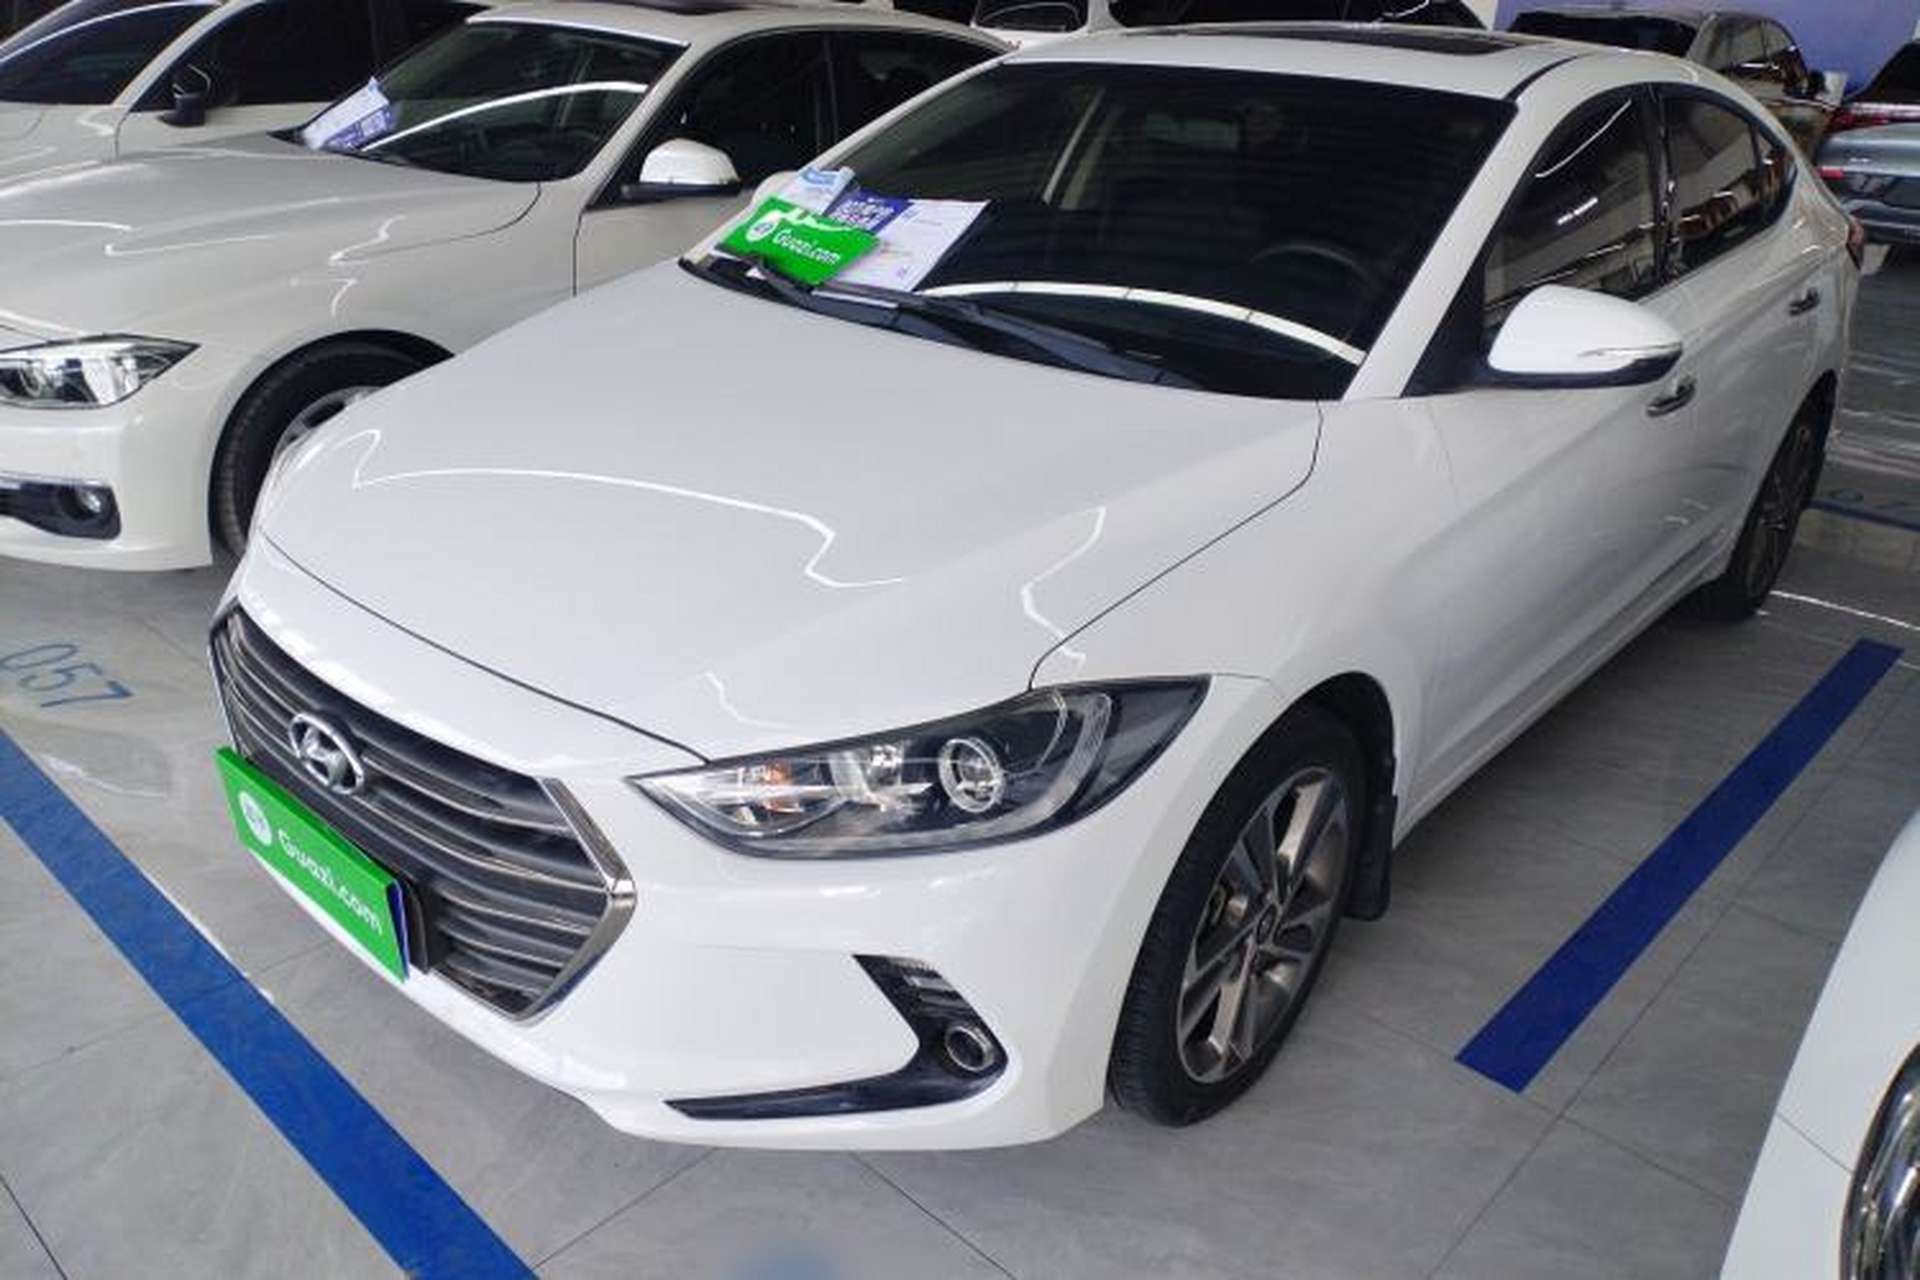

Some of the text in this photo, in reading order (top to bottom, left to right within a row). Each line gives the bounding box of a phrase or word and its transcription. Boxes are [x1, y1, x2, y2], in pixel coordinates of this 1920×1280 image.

[772, 229, 841, 266] Guazi.com
[0, 643, 134, 708] 057
[277, 828, 384, 936] Guazi.com
